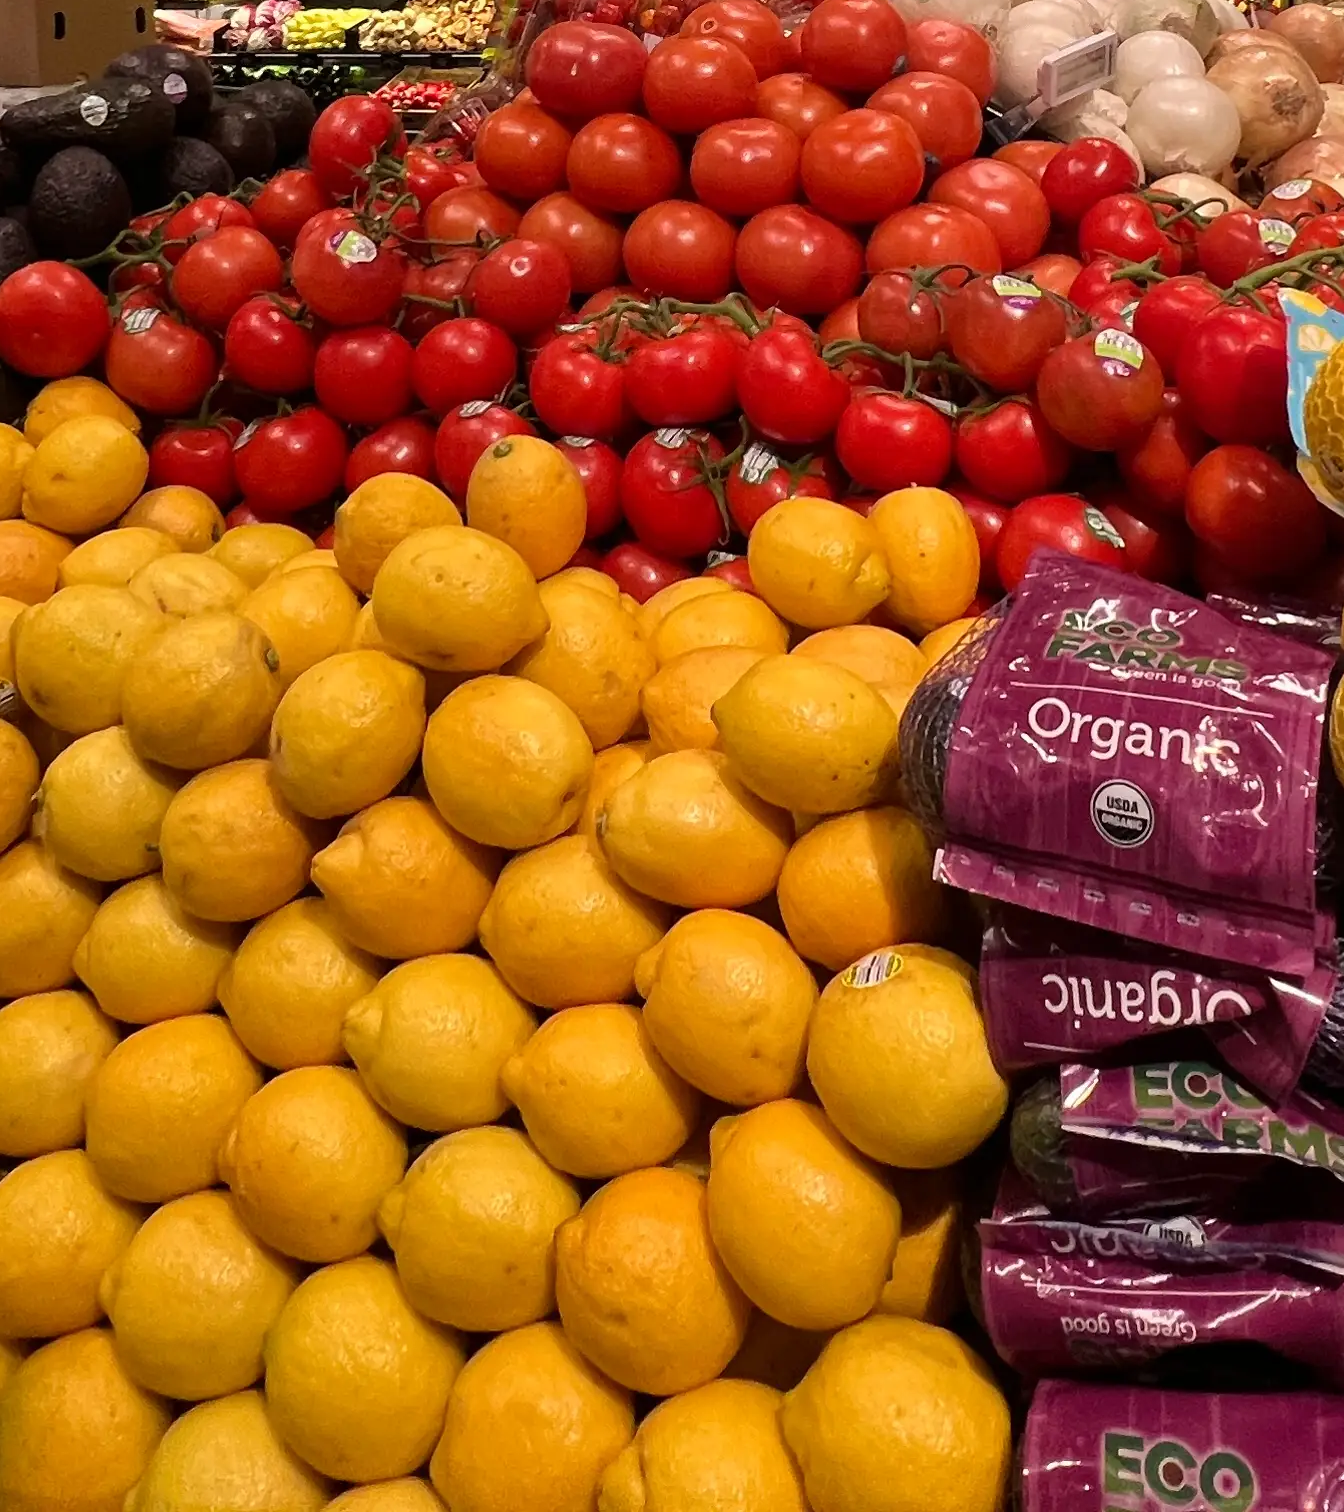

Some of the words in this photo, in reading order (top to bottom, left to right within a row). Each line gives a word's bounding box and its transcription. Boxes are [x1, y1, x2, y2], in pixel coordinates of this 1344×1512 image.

[1044, 632, 1251, 682] FARMS
[1028, 697, 1240, 776] Organic
[1101, 813, 1144, 832] ORGANIC
[1106, 795, 1140, 815] USDA
[1041, 969, 1252, 1029] Organic
[1060, 1312, 1110, 1336] good
[1114, 1318, 1132, 1338] is
[1103, 1431, 1256, 1510] ECO
